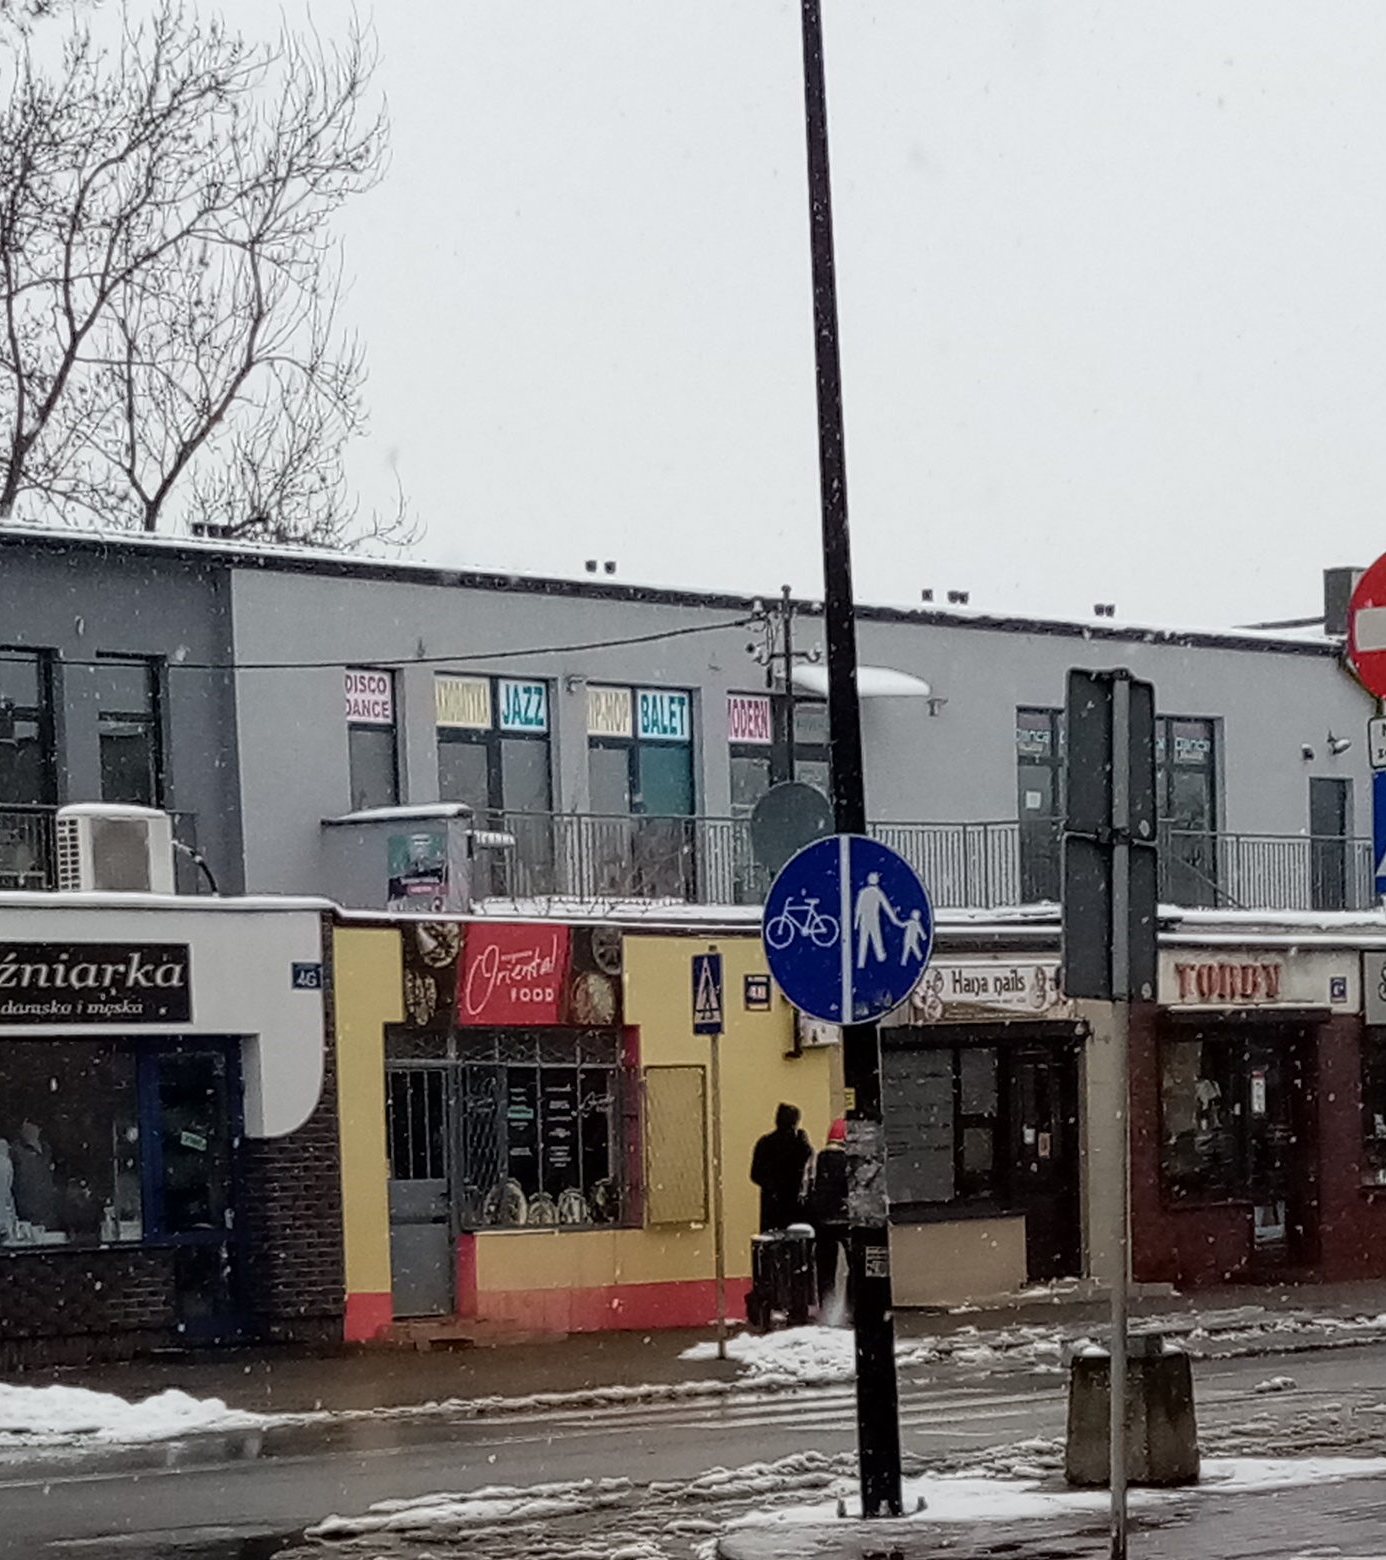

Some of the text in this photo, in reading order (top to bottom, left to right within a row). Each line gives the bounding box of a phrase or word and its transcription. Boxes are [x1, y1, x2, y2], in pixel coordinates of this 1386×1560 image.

[344, 674, 387, 694] DISCO
[502, 684, 544, 726] JAZZ
[641, 694, 686, 736] BALET
[466, 934, 558, 1016] Oriental
[994, 969, 1026, 996] nails
[0, 1000, 72, 1016] damska
[76, 1001, 84, 1015] i
[511, 988, 554, 1003] FOOD
